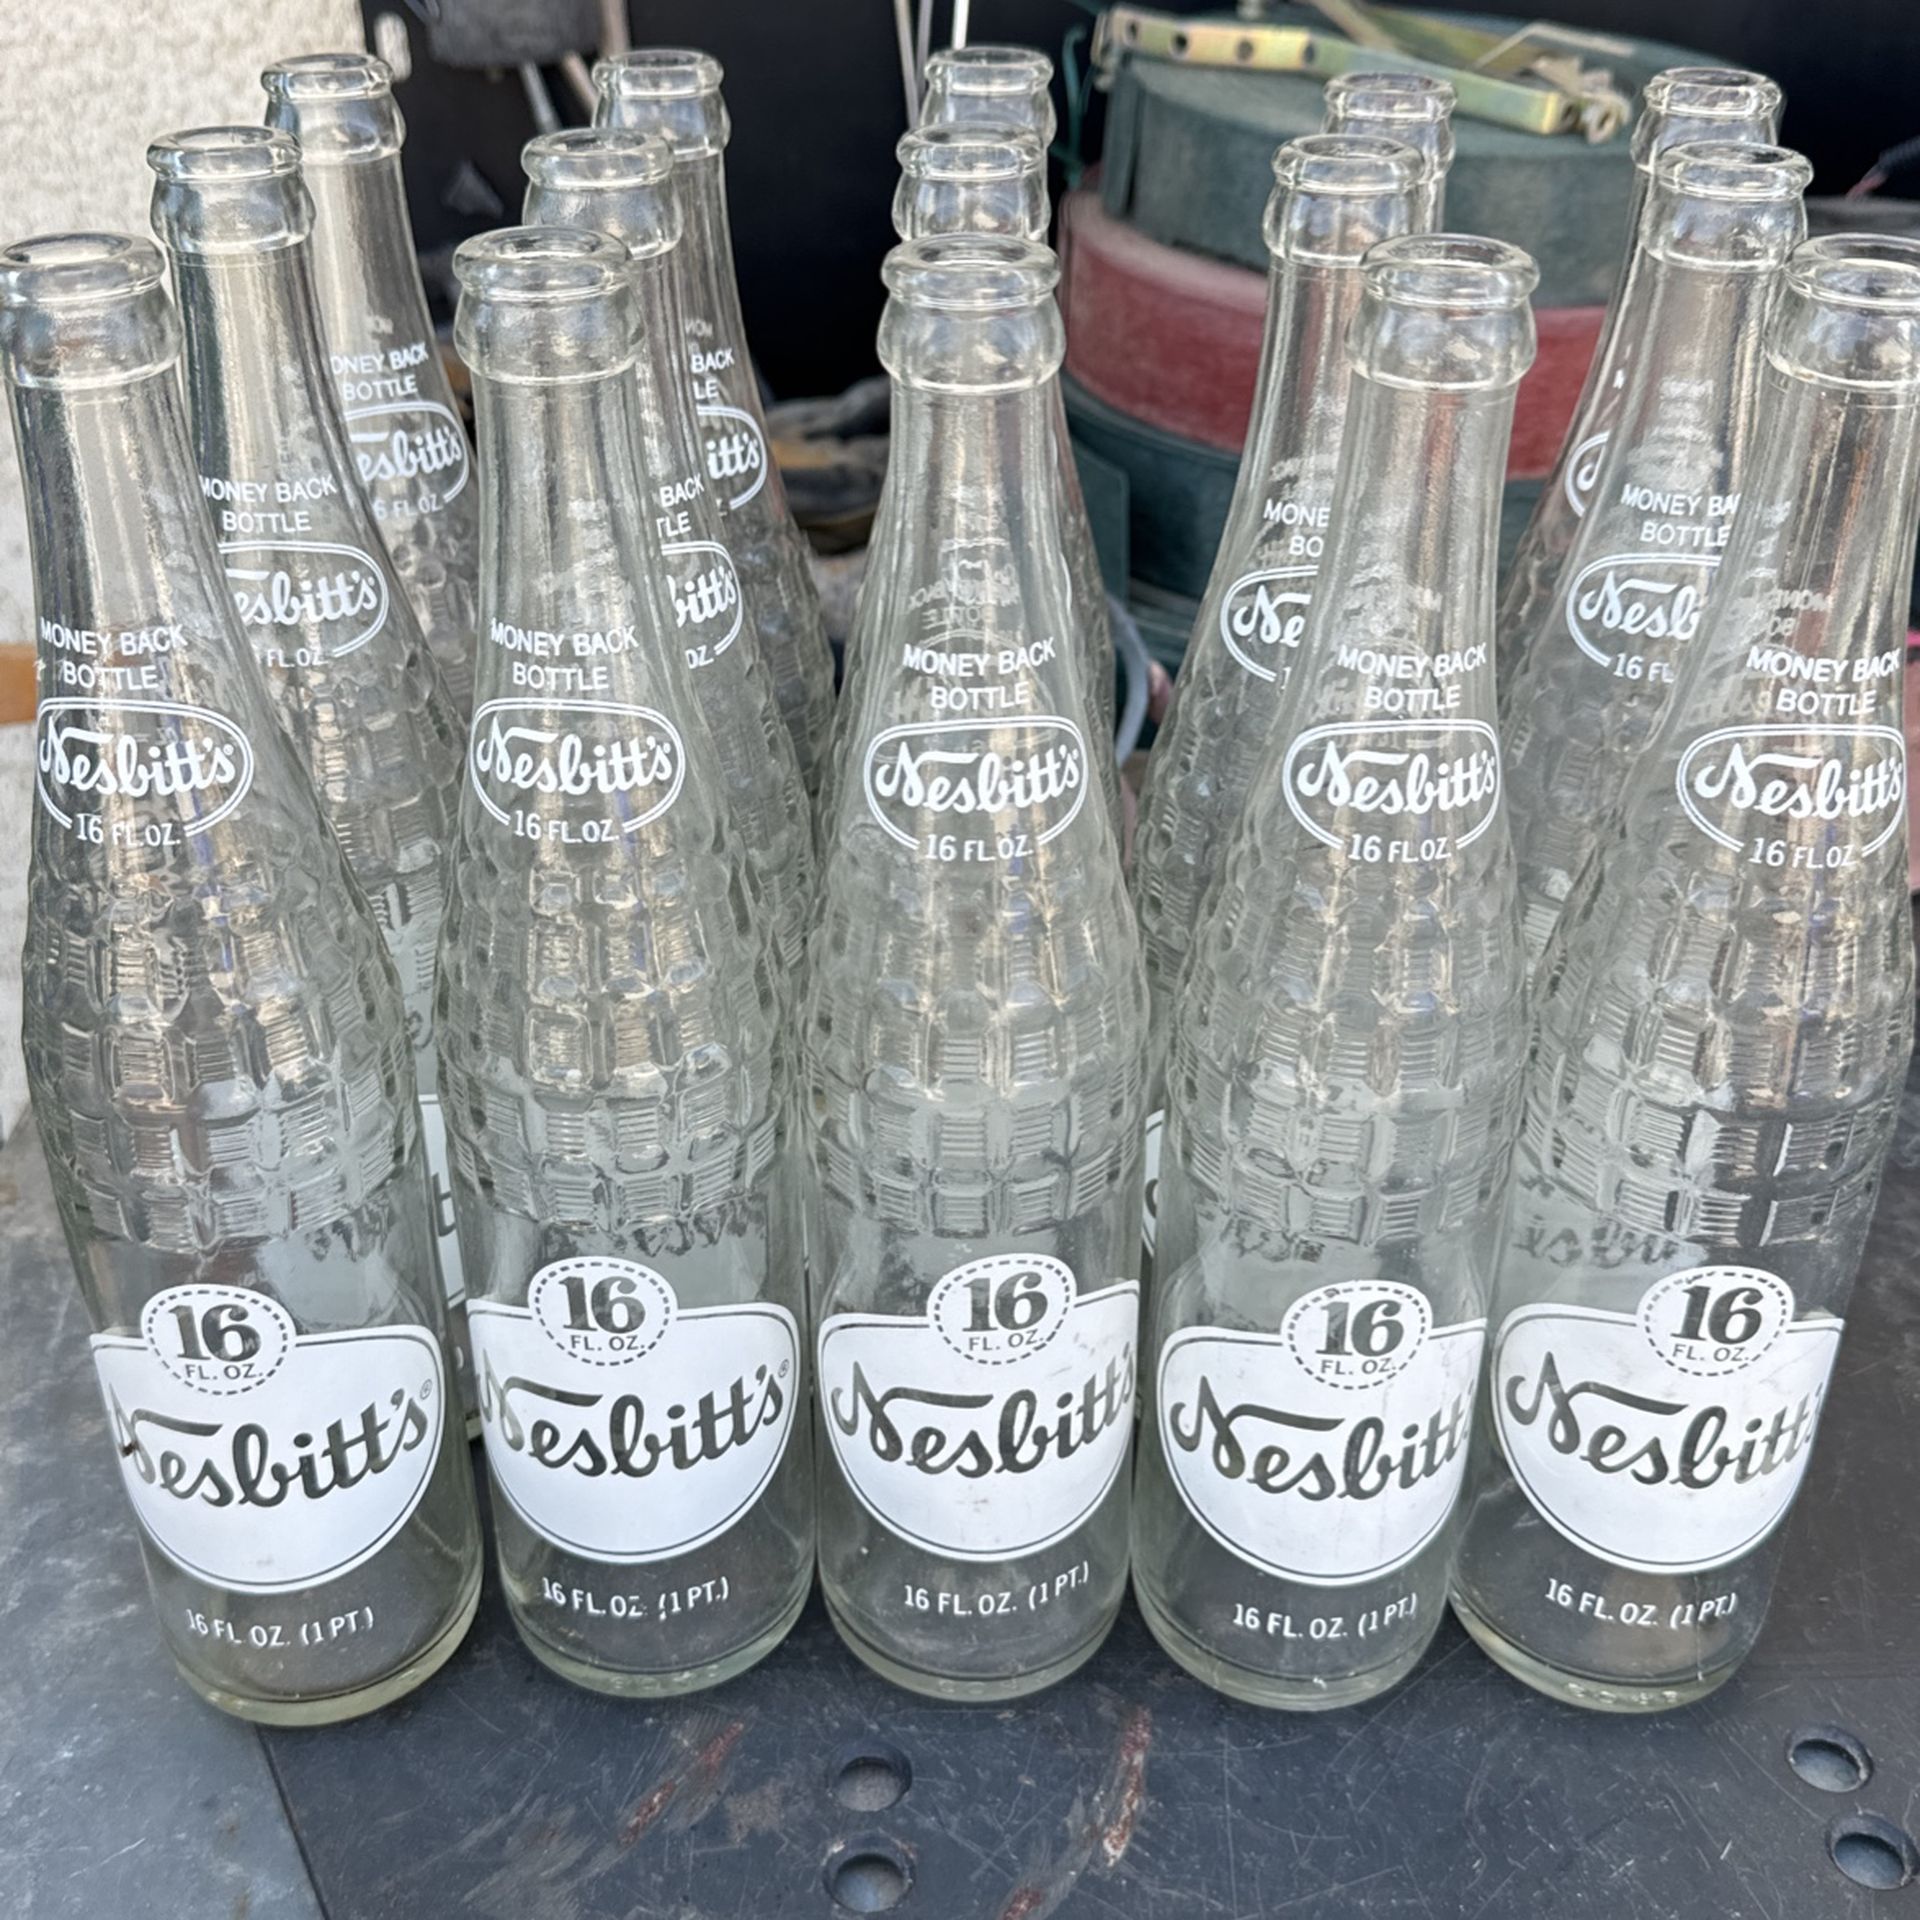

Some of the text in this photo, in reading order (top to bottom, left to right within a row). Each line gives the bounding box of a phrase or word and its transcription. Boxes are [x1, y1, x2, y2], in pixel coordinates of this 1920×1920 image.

[330, 342, 429, 374] ONEY BACK
[691, 348, 734, 373] BACK
[342, 375, 418, 401] BOTTLE
[275, 474, 337, 502] BACK
[660, 474, 704, 508] BACK
[1621, 483, 1702, 516] MONEY
[222, 511, 312, 533] BOTTLE
[1264, 499, 1331, 527] MONE
[1640, 521, 1732, 547] BOTTLE
[40, 617, 188, 655] MONEY BACK
[491, 618, 639, 656] MONEY BACK
[903, 637, 1056, 677] MONEY BACK
[1337, 642, 1487, 678] MONEY BACK
[1614, 653, 1643, 680] 16
[1747, 646, 1900, 682] MONEY BACK
[63, 660, 159, 690] BOTTLE
[513, 661, 609, 690] BOTTLE
[931, 682, 1029, 710] BOTTLE
[1365, 684, 1461, 712] BOTTLE
[1776, 688, 1876, 715] BOTTLE
[39, 716, 235, 797] Nesbitt's
[477, 716, 673, 795] Nesbitt's
[876, 741, 1080, 813] Nesbitt's
[1297, 740, 1495, 814] Nesbitt's
[1694, 742, 1902, 819] Nesbitt's
[77, 813, 104, 844] 16
[515, 811, 541, 840] 16
[925, 834, 956, 861] 16
[1348, 834, 1381, 863] 16
[1748, 838, 1785, 867] 16
[558, 1276, 646, 1334] 16
[962, 1271, 1048, 1332] 16
[1670, 1285, 1764, 1345] 16
[168, 1303, 261, 1362] 16
[570, 1335, 645, 1351] FL. OZ.
[969, 1329, 1045, 1351] FL. OZ.
[1316, 1299, 1404, 1357] 16
[1320, 1357, 1396, 1375] FL. OZ.
[1672, 1344, 1749, 1362] FL. OZ.
[185, 1363, 263, 1381] FL. OZ.
[542, 1577, 565, 1606] 16
[572, 1589, 606, 1615] FL.
[687, 1576, 728, 1608] PT.)
[904, 1585, 929, 1611] 16
[938, 1594, 972, 1615] FL.
[978, 1591, 1017, 1615] OZ.
[1055, 1560, 1089, 1597] PT.)
[1545, 1578, 1572, 1606] 16
[1579, 1592, 1614, 1620] FL.
[1619, 1602, 1658, 1626] OZ.
[186, 1608, 208, 1636] 16
[251, 1625, 291, 1647] OZ.
[1233, 1603, 1260, 1629] 16
[1267, 1615, 1303, 1639] FL.
[1309, 1617, 1348, 1639] OZ.
